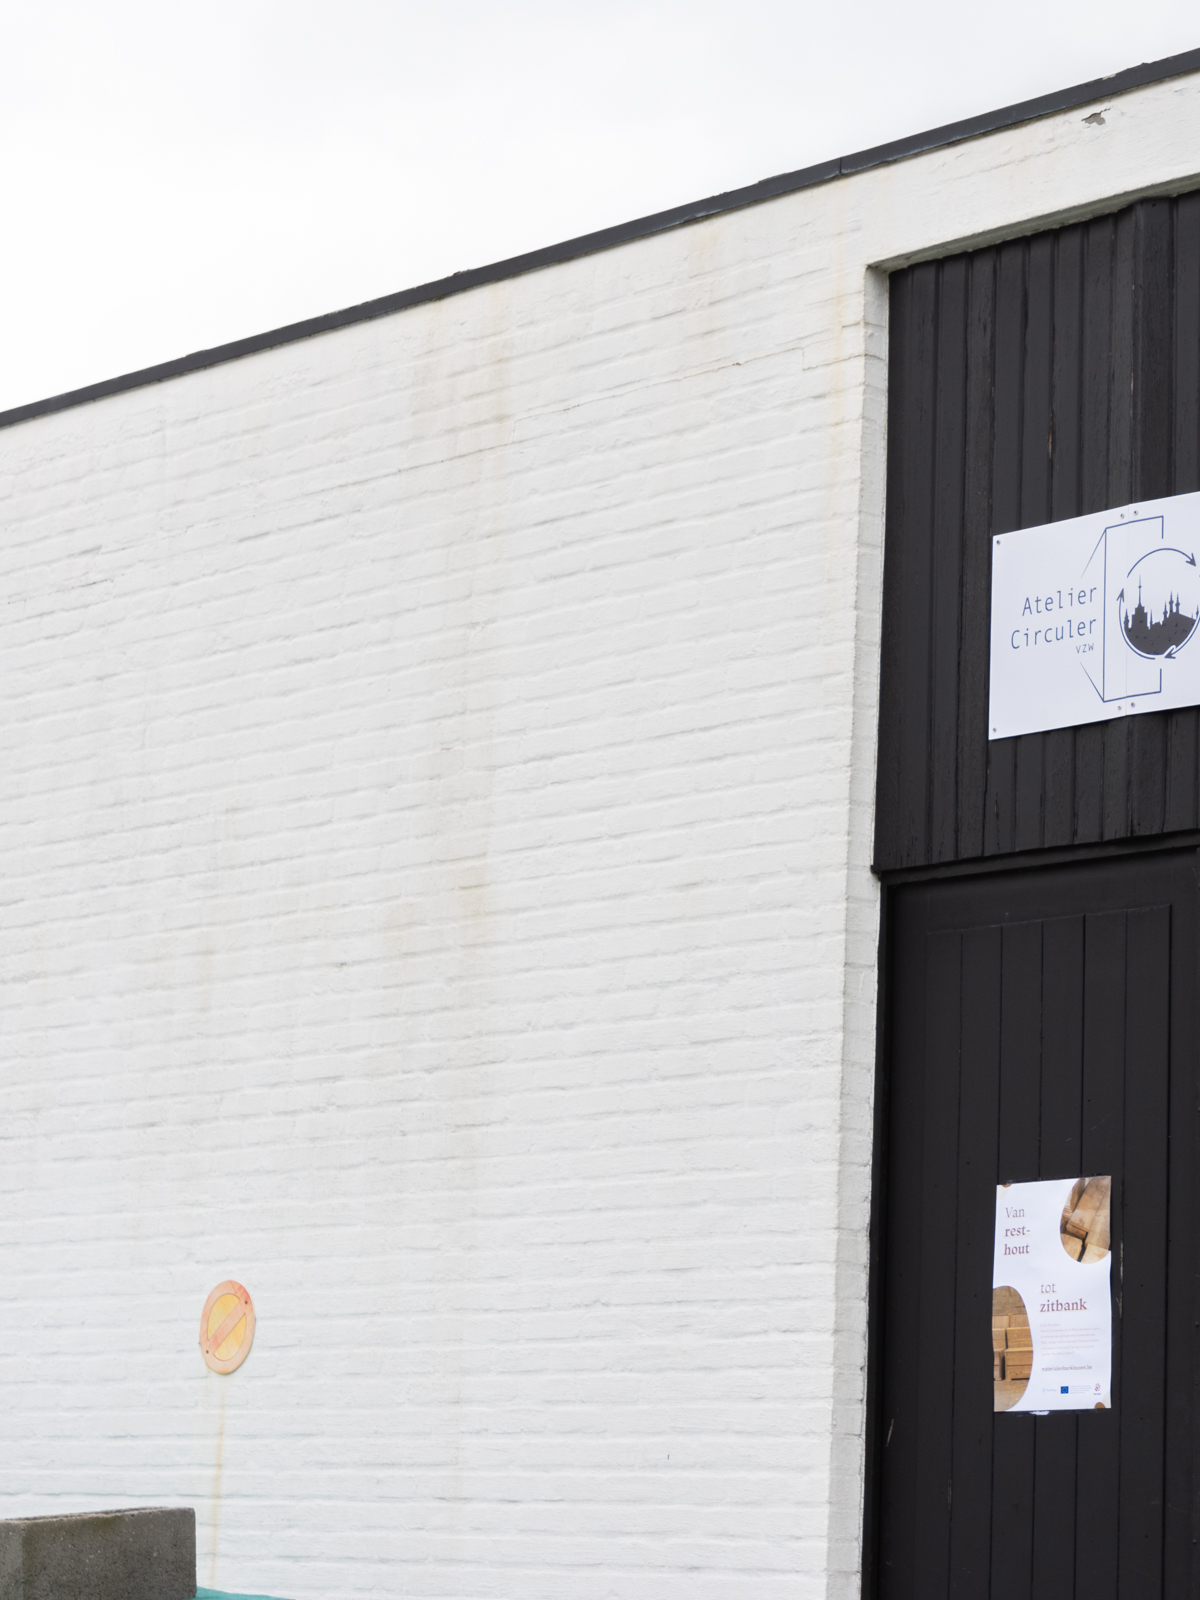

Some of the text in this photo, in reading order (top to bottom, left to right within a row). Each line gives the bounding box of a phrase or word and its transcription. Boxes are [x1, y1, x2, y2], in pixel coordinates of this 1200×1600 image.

[1022, 586, 1097, 616] Atelier
[1011, 618, 1097, 649] Circuler
[1005, 1207, 1025, 1218] Van
[1005, 1225, 1031, 1237] rest-
[1004, 1243, 1030, 1255] hout
[1040, 1283, 1056, 1293] tot
[1040, 1298, 1087, 1312] zitbank
